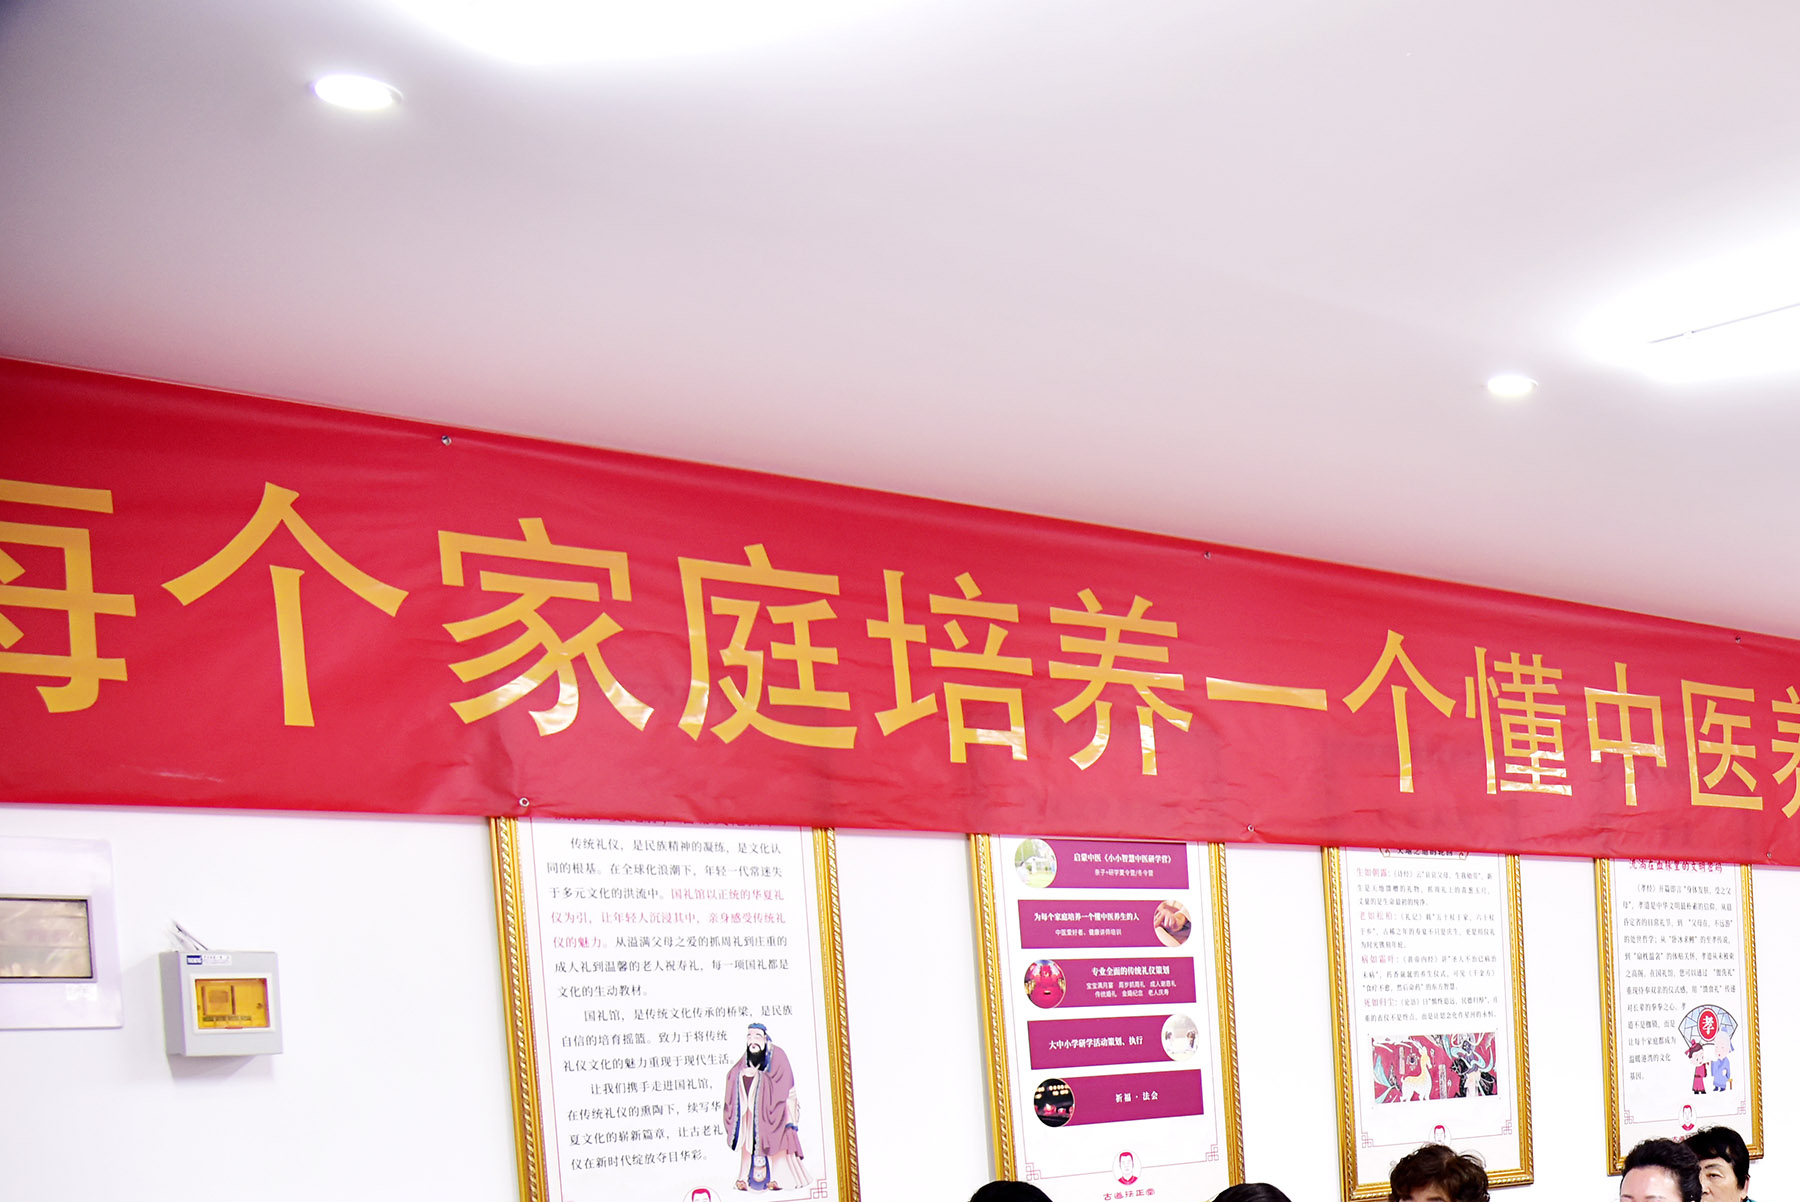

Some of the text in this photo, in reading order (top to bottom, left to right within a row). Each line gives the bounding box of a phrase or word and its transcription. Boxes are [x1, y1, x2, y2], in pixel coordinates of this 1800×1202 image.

[571, 838, 781, 854] 传统礼仪，是民族精神的凝练，是文化认
[547, 862, 782, 877] 同的根基。在全球化浪潮下，年轻一代常迷失
[551, 887, 784, 900] 于多元文化的洪流中。国礼馆以正统的华夏礼
[552, 912, 785, 924] 仪为引，让年轻人沉浸其中，亲身感受传统礼
[556, 959, 788, 973] 成人礼到温馨的老人祝寿礼，每一项国礼都是
[560, 985, 649, 997] 文化的生动教材。
[584, 1005, 792, 1021] 国礼馆，是传统文化传承的桥梁，是民族
[1702, 1016, 1714, 1035] 孝
[562, 1030, 727, 1047] 自信的培育摇篮。致力于将传统
[564, 1054, 735, 1072] 礼仪文化的魅力重现于现代生活。
[568, 1102, 721, 1121] 在传统礼仪的熏陶下，续写华
[570, 1125, 723, 1145] 夏文化的崭新篇章，让古老礼
[572, 1150, 708, 1170] 仪在新时代绽放夺目华彩。
